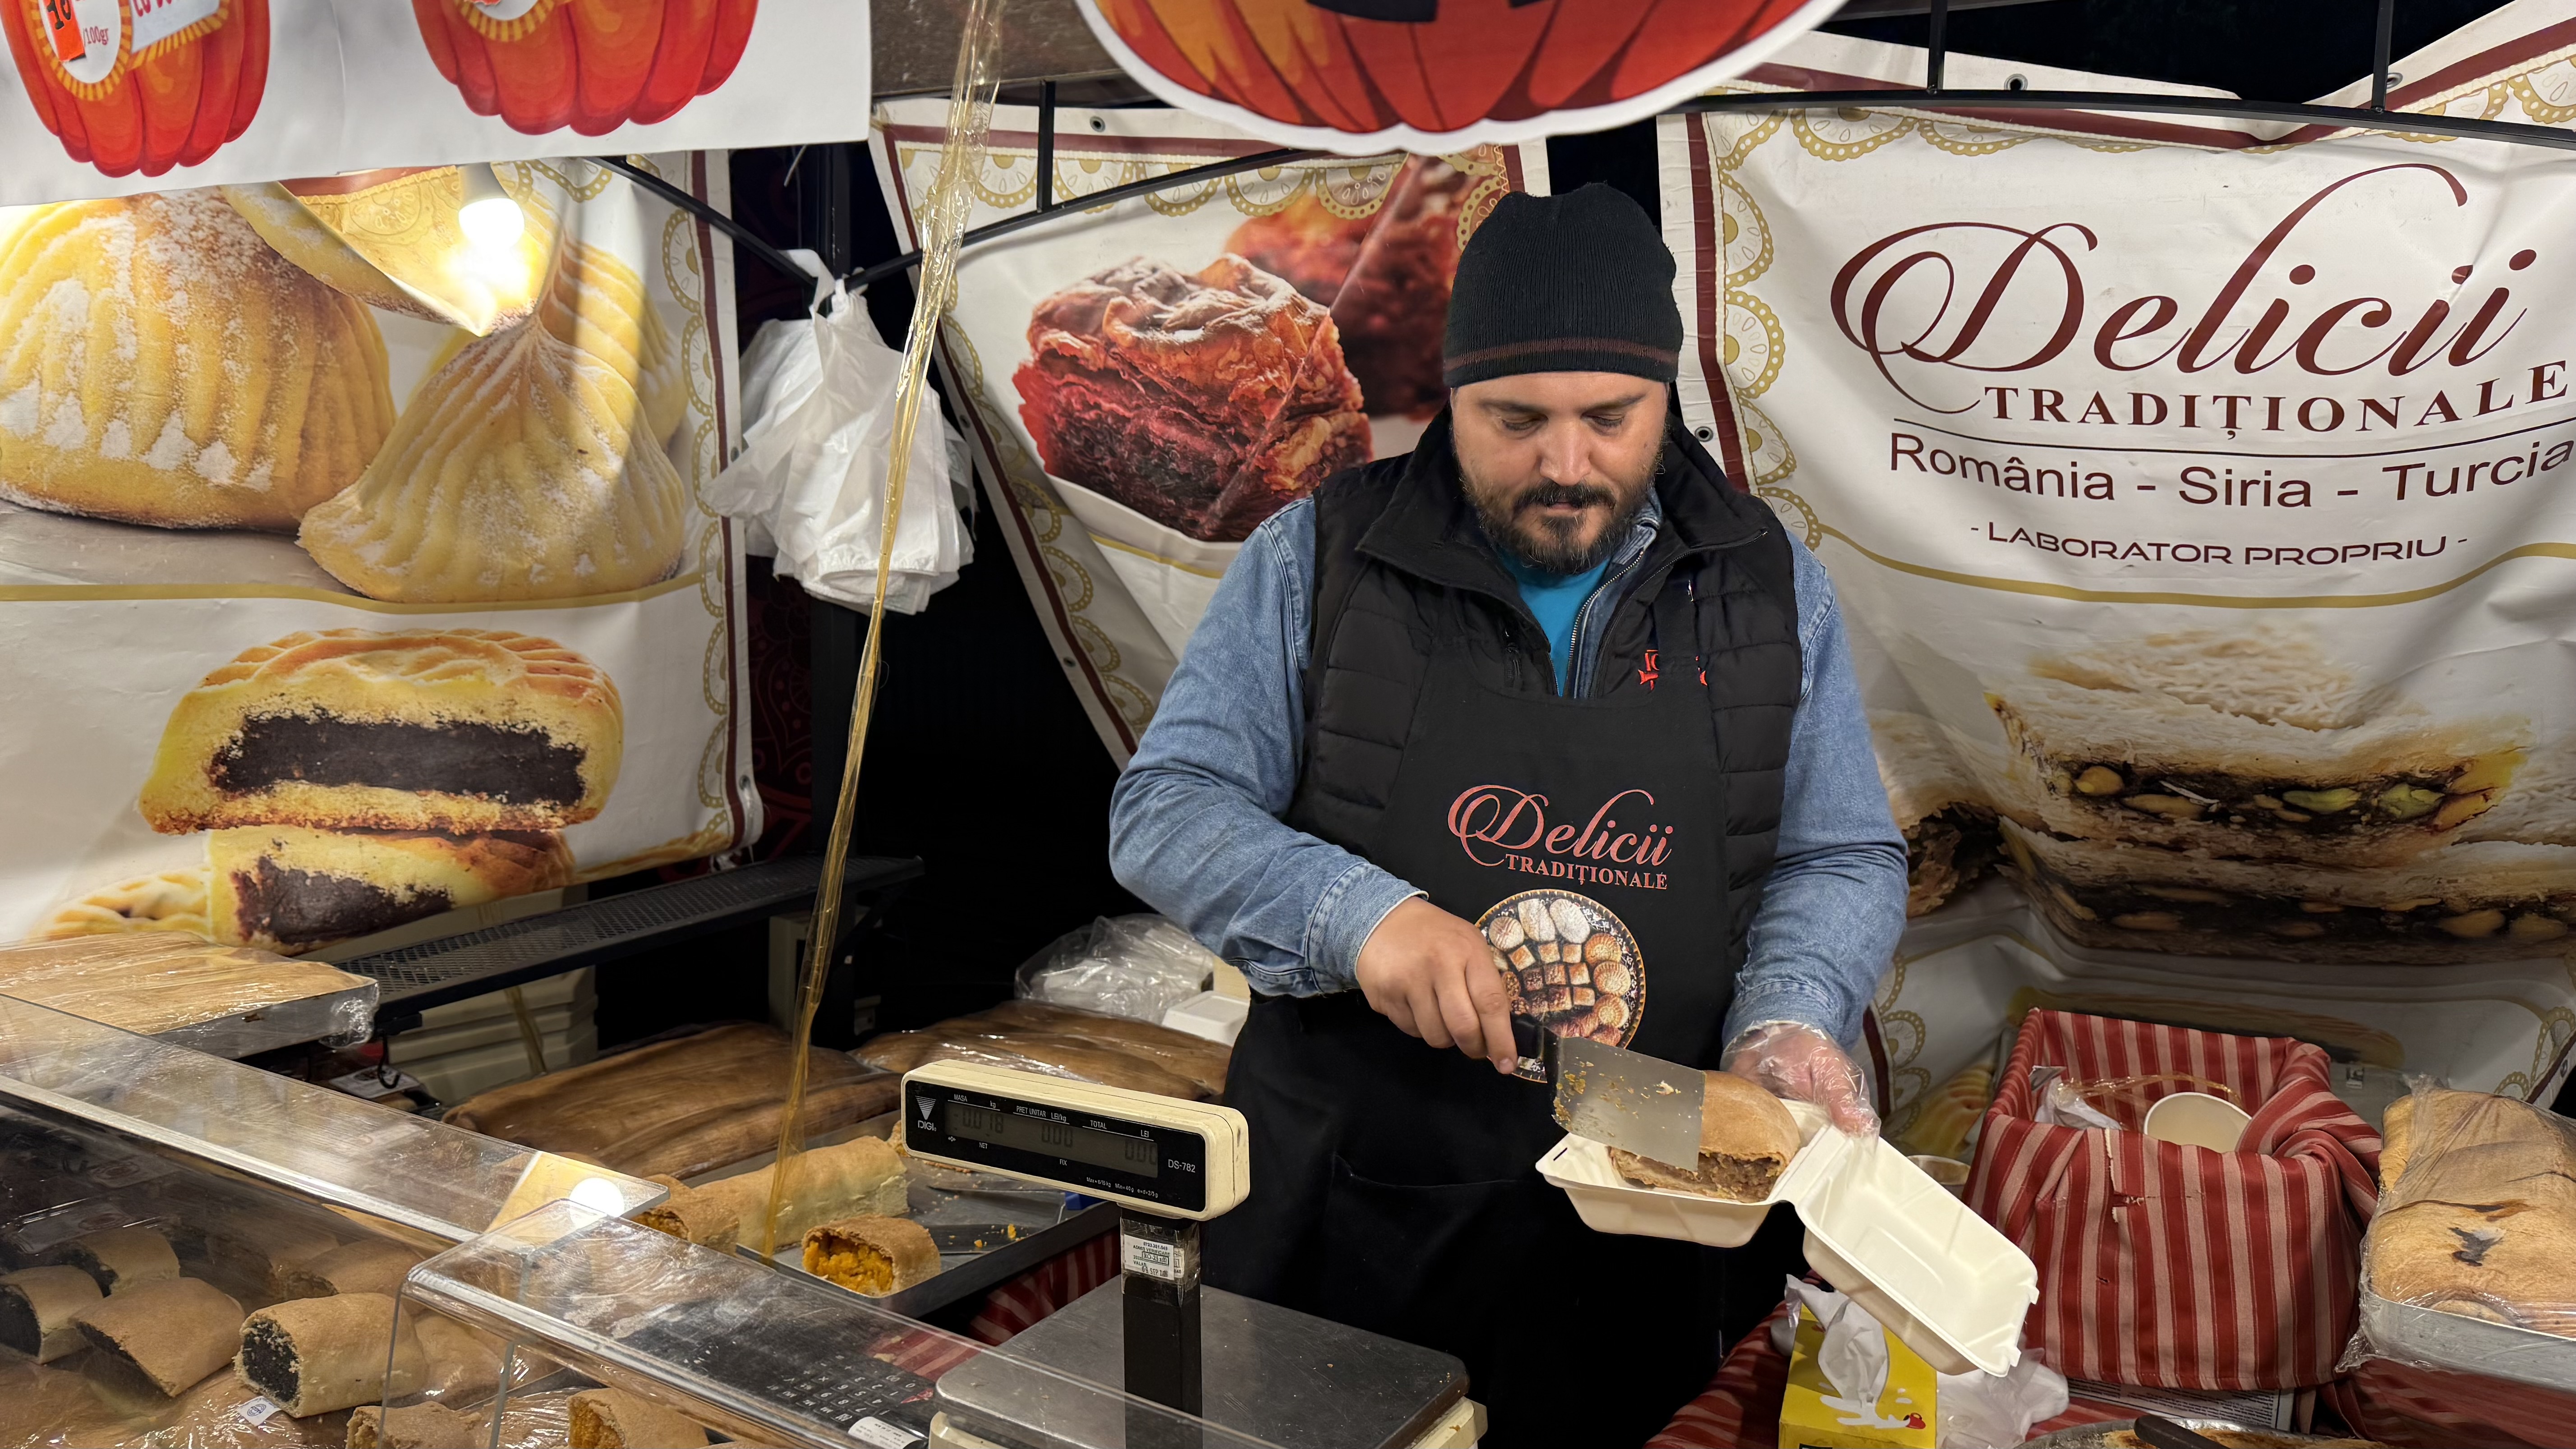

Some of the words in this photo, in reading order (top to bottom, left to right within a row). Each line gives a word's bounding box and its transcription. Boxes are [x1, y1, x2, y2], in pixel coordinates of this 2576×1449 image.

[1831, 164, 2536, 414] Delicii
[1985, 360, 2567, 440] TRADIȚIONALE
[1891, 433, 2115, 501] România
[2179, 467, 2311, 508] Siria
[2383, 441, 2574, 501] Turcia
[1989, 522, 2233, 566] LABORATOR
[2245, 536, 2447, 566] PROPRIU
[1448, 785, 1674, 867] Delicii
[1029, 1108, 1046, 1117] UNITAR
[1090, 1120, 1107, 1129] TOTAL
[1168, 1159, 1196, 1173] DS-782
